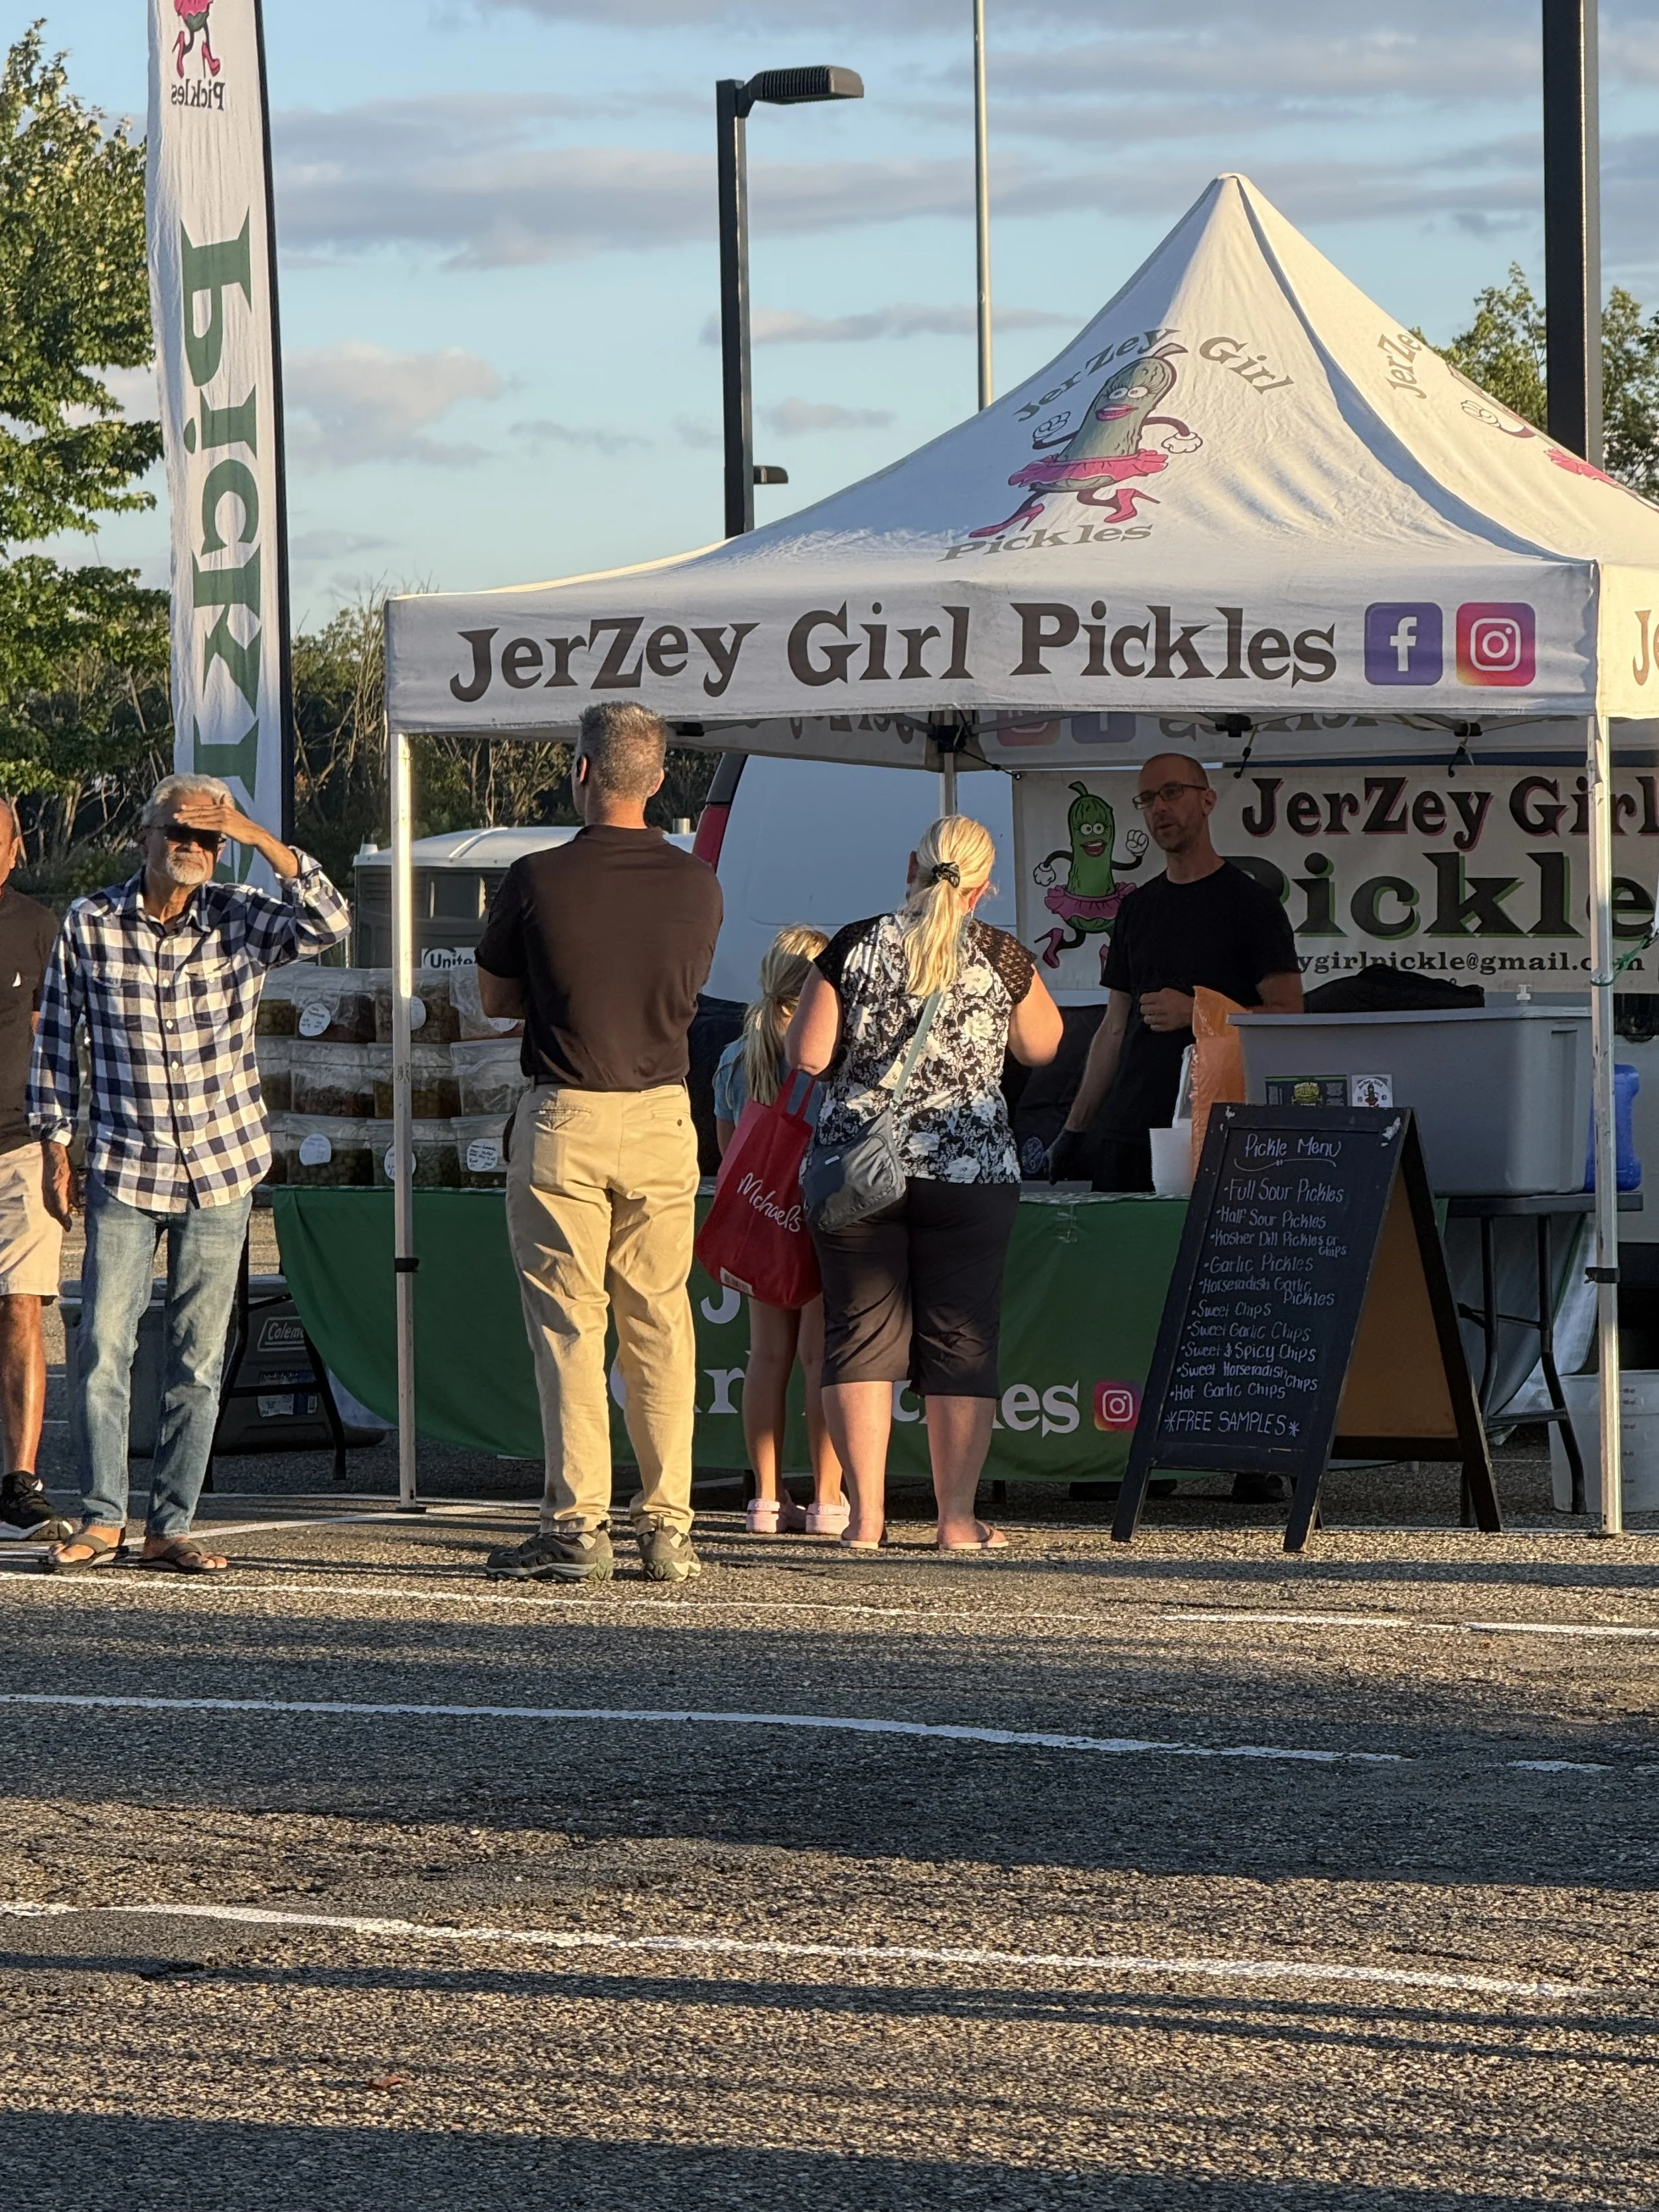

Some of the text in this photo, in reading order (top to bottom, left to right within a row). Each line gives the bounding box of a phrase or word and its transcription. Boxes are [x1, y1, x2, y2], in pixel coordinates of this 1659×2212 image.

[1013, 328, 1295, 422] JerZey Girl
[937, 524, 1155, 563] Pickles
[450, 600, 1336, 703] JerZey Girl Pickles
[1242, 775, 1659, 852] JerZey Girl
[1245, 1133, 1342, 1157] Pickle Menu
[1229, 1177, 1345, 1203] Full Sour Pickles
[1220, 1205, 1327, 1228] Half Sour Pickles
[1214, 1228, 1339, 1247] Kosher Dill Pickles or
[1209, 1252, 1314, 1274] Garlic Pickles
[1202, 1275, 1312, 1294] Horseradish Garlic
[1196, 1299, 1272, 1319] Sweet Chips
[1283, 1290, 1336, 1306] Pickles
[1190, 1320, 1312, 1344] Sweet Garlic Chips
[1185, 1341, 1222, 1358] Sweet
[1234, 1341, 1275, 1363] Spicy
[1279, 1343, 1317, 1363] Chips
[1180, 1361, 1288, 1380] Sweet Horseradish
[1174, 1381, 1286, 1402] Hot Garlic Chips
